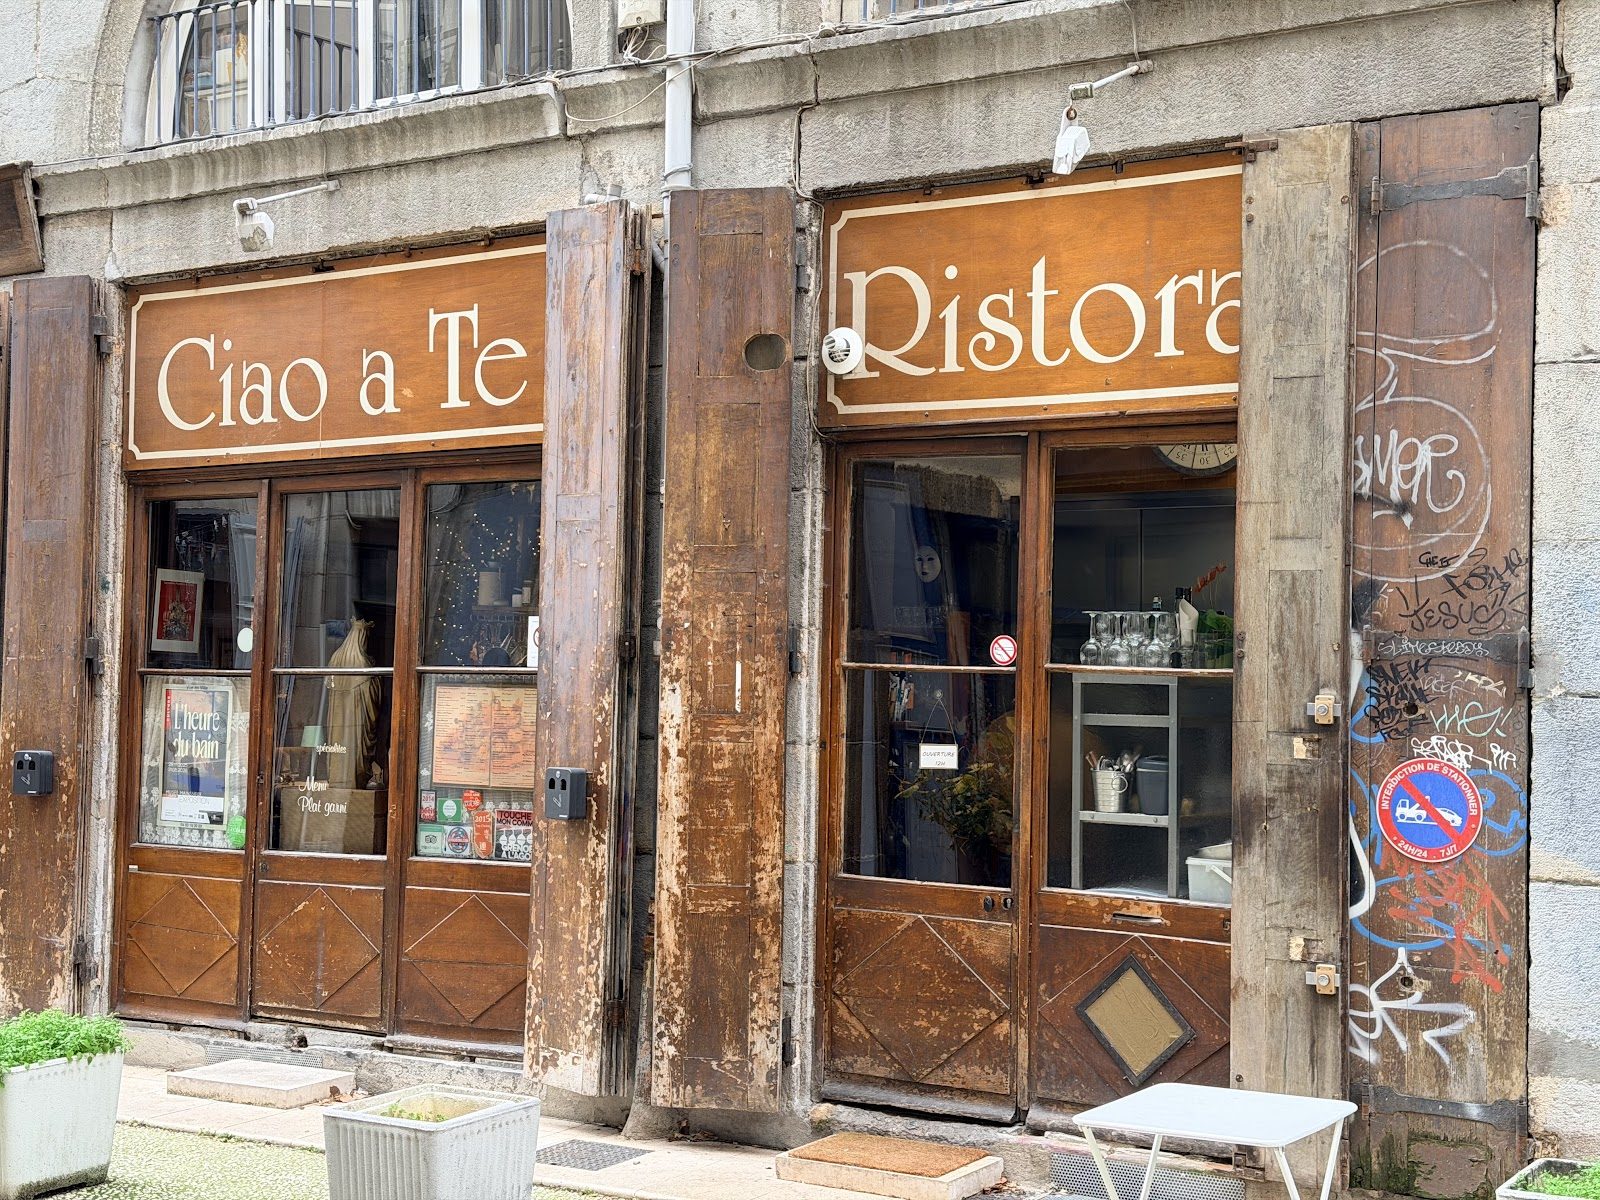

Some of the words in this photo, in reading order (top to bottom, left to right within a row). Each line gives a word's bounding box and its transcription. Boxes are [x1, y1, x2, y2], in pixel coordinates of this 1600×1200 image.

[157, 334, 328, 431] Ciao
[359, 348, 401, 416] a
[428, 303, 528, 409] Te
[174, 703, 220, 732] L'heure
[173, 730, 189, 758] du
[191, 731, 219, 760] bain
[298, 776, 328, 792] Menu
[1381, 763, 1425, 810] INTERDICTION
[1426, 762, 1441, 772] DE
[1441, 767, 1478, 816] STATIONNER
[297, 796, 322, 814] Plat
[324, 801, 348, 817] garni
[499, 810, 532, 821] TOUCHE
[474, 814, 491, 823] 2015
[496, 817, 511, 825] MON
[1397, 839, 1428, 858] 24H/24
[1439, 843, 1458, 858] 7J/7
